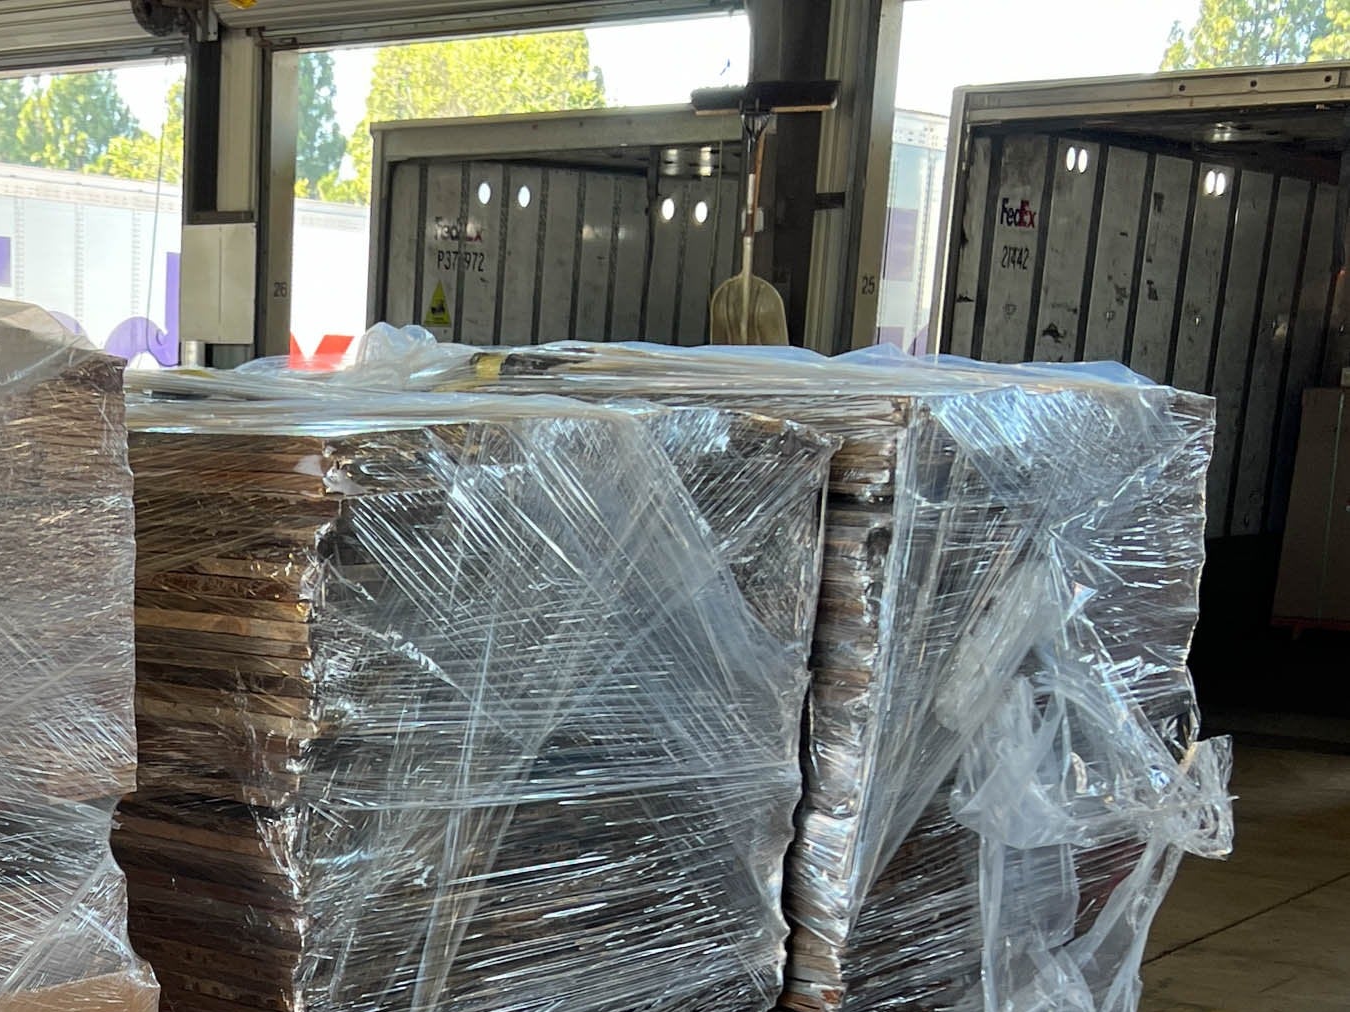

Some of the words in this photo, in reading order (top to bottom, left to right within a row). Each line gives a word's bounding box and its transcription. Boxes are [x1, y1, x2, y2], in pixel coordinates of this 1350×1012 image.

[1000, 197, 1037, 228] FedEx
[437, 250, 485, 272] P37972
[274, 281, 288, 298] 26
[861, 275, 875, 295] 25
